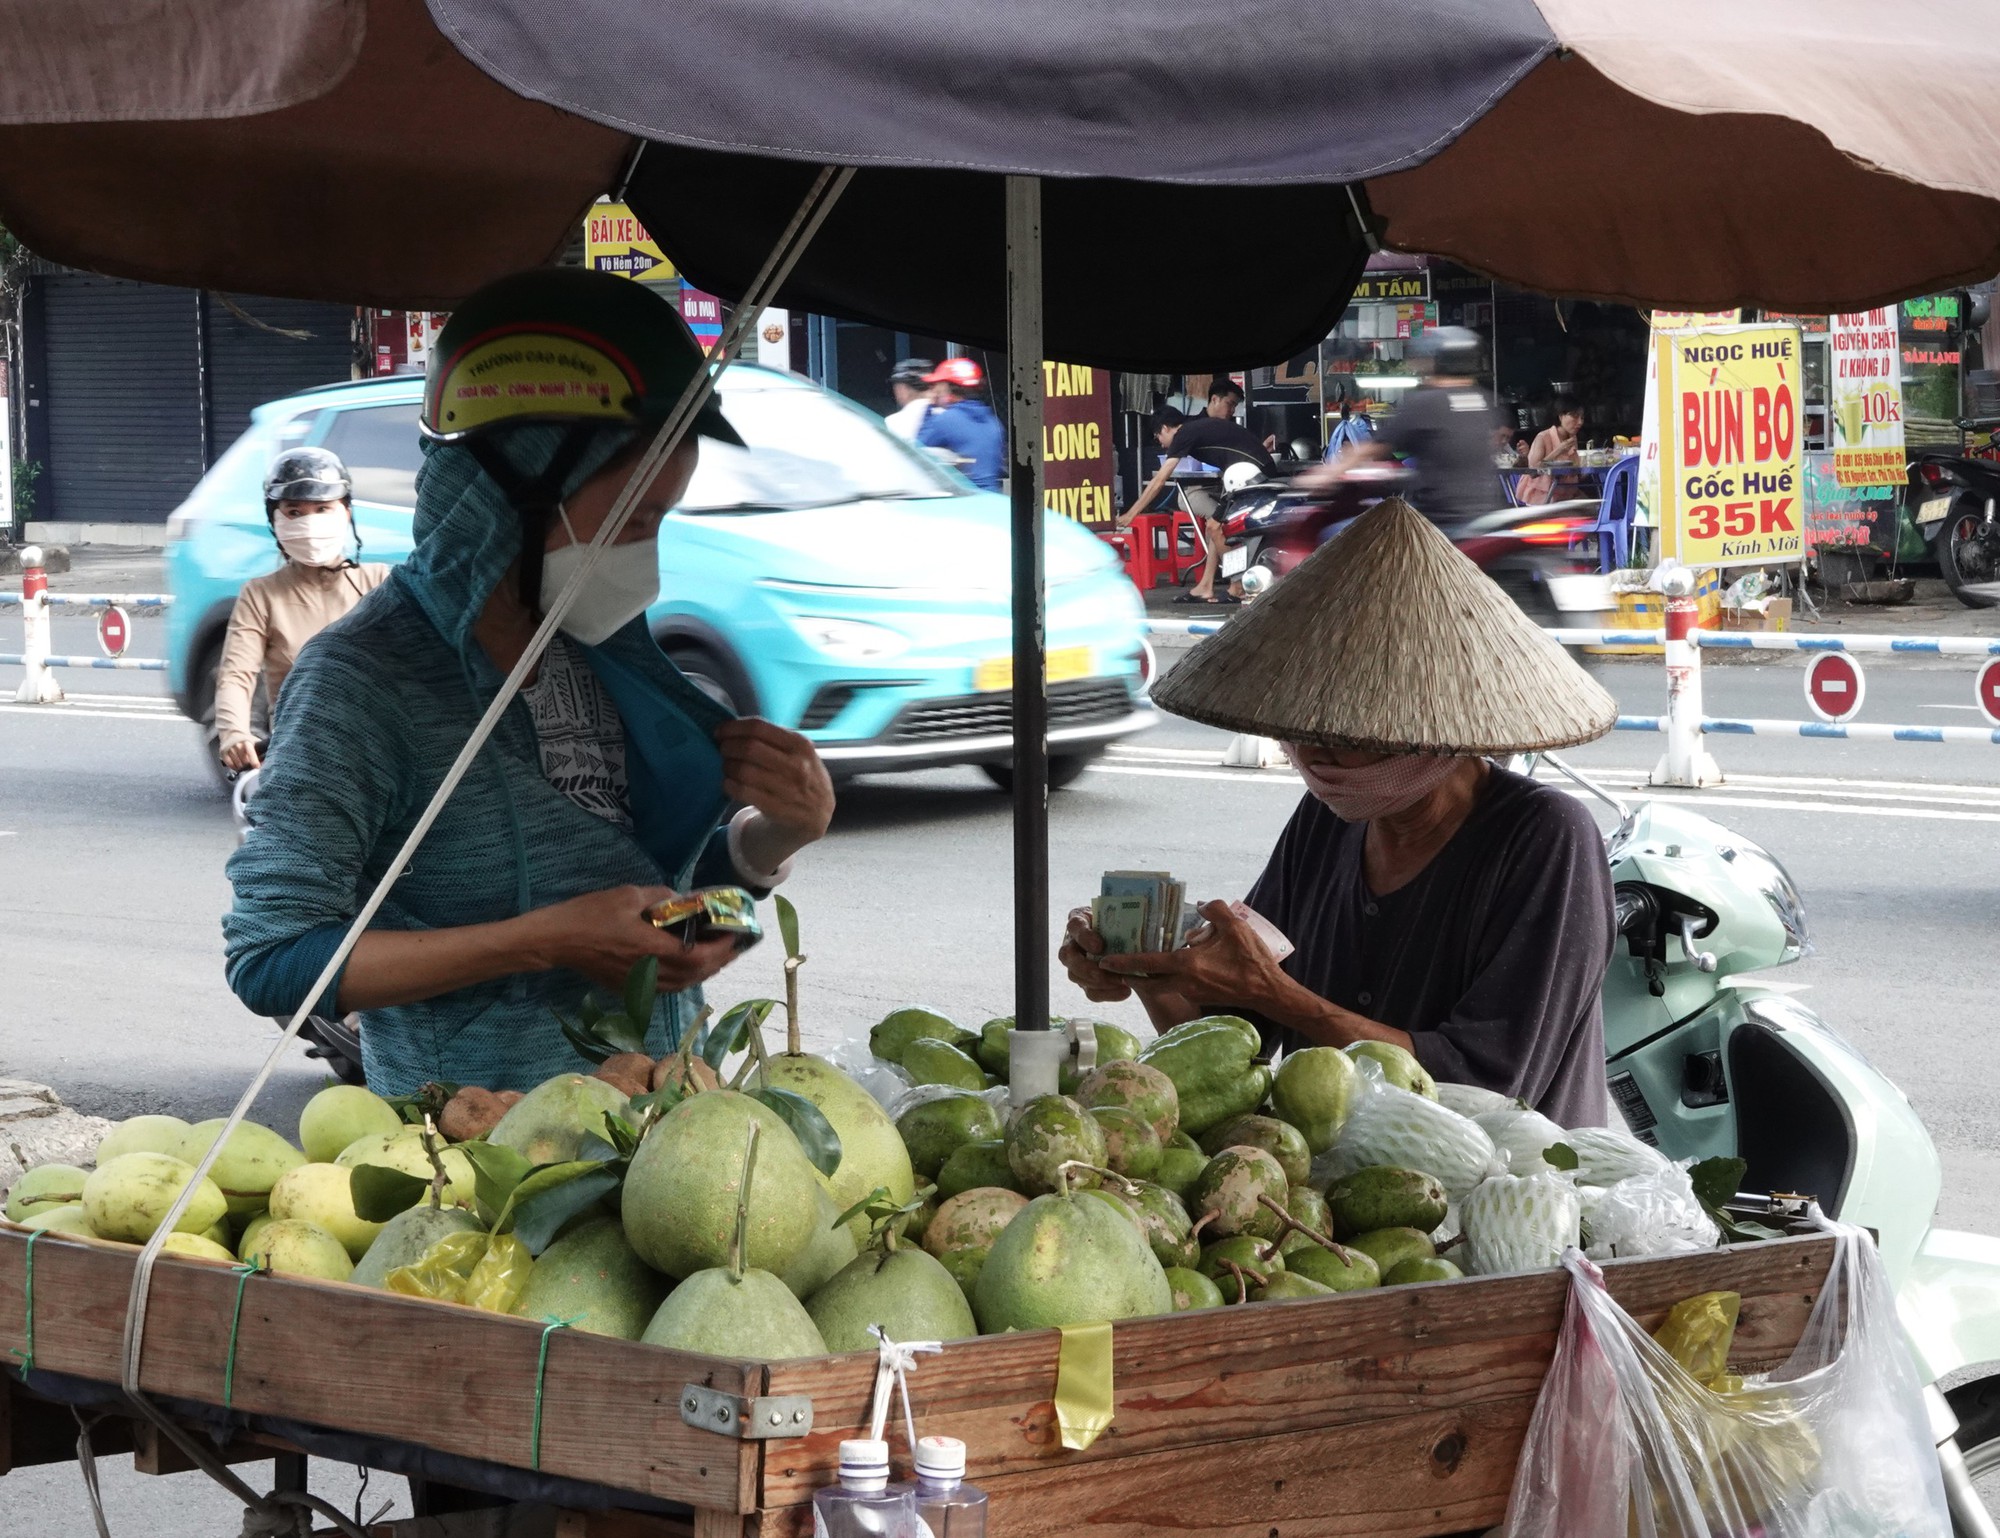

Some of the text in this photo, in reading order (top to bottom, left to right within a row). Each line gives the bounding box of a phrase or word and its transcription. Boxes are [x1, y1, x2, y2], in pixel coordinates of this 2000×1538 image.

[591, 214, 612, 243] BÃI
[617, 219, 632, 242] XE
[601, 254, 652, 270] Vô Hẻm 20m
[1377, 276, 1421, 296] TẤM
[1684, 337, 1793, 365] NGỌC HUỆ
[1872, 327, 1897, 349] CHẤT
[1683, 362, 1794, 468] BÚN BÒ
[1862, 391, 1900, 423] 10k
[1043, 422, 1100, 461] LONG
[1686, 464, 1795, 499] Gốc Huế
[1688, 497, 1795, 539] 35K
[1721, 535, 1799, 557] Kính Mời
